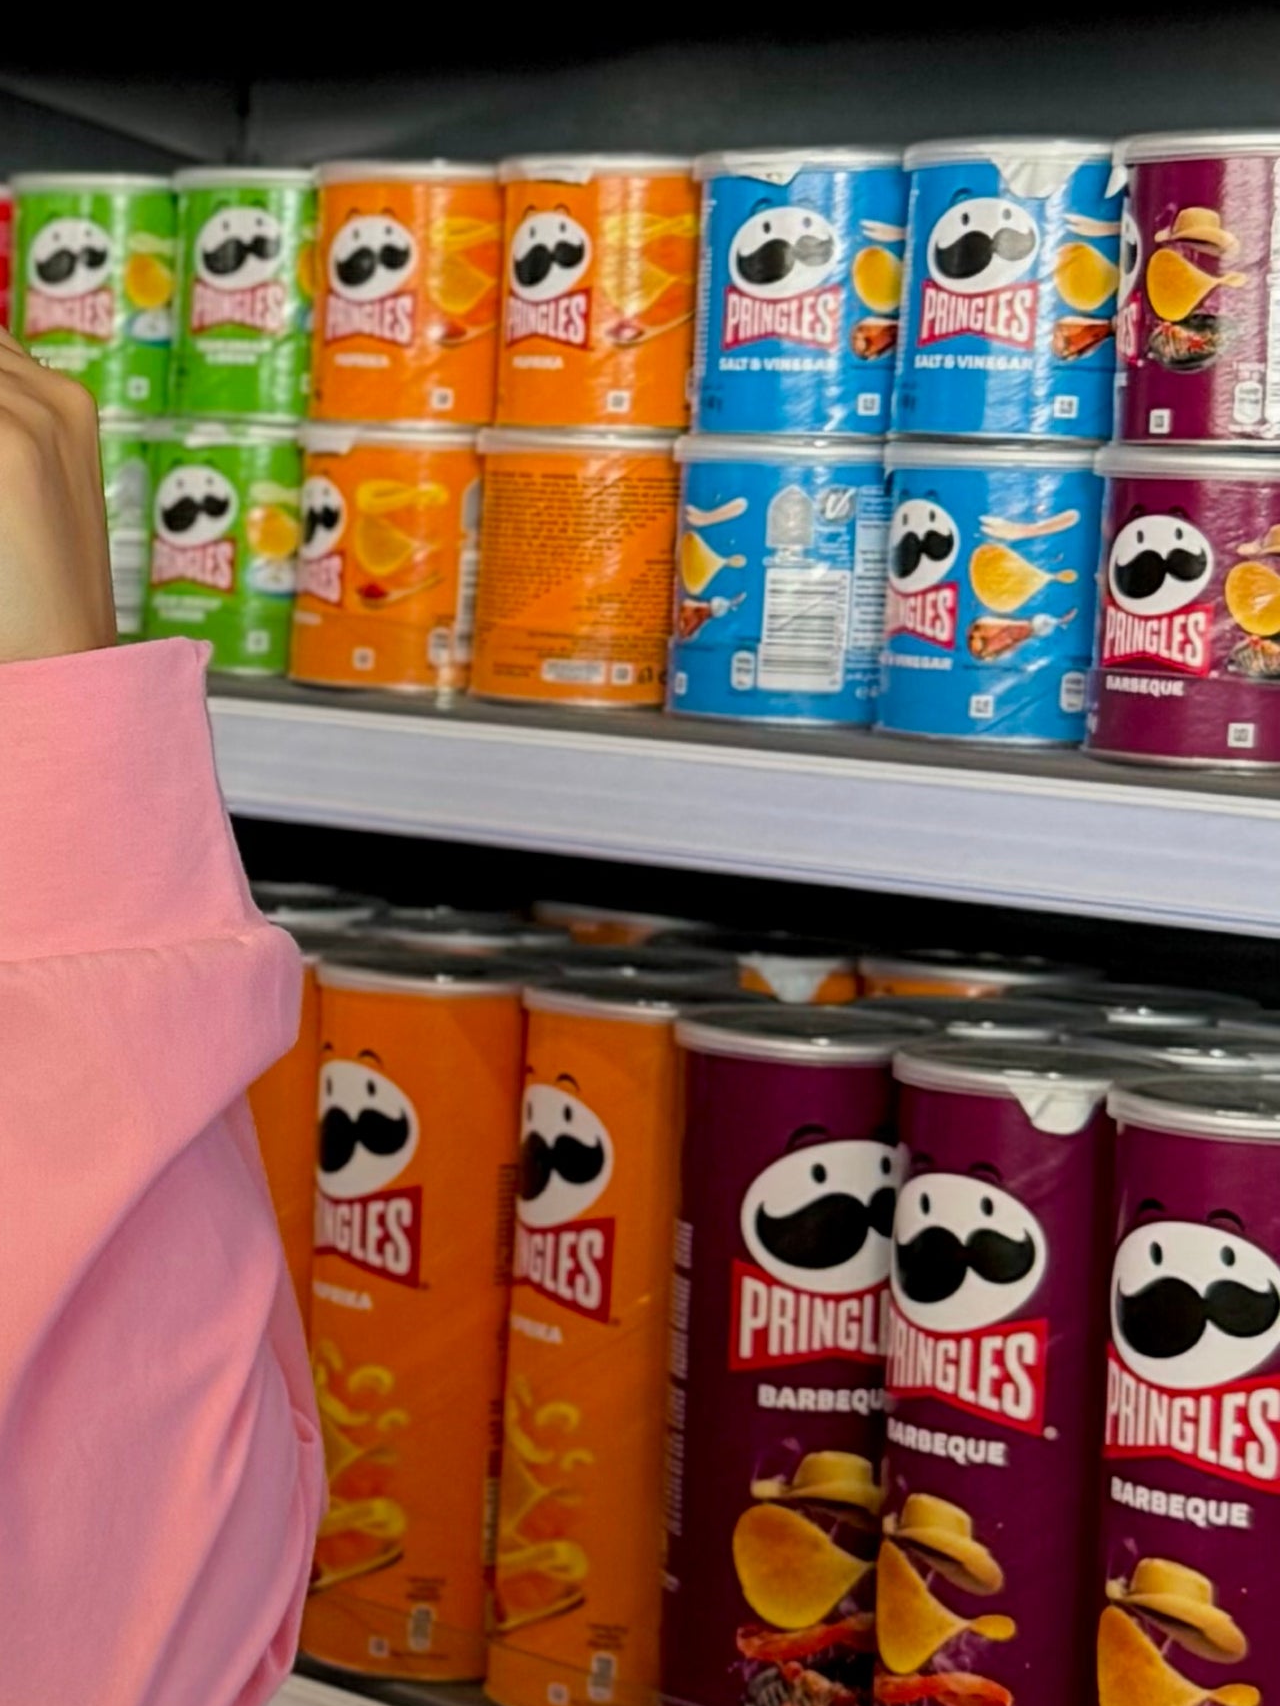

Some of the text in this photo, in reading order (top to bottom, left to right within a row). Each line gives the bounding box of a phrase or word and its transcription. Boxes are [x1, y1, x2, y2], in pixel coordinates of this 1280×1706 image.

[725, 294, 837, 345] PRINGLES
[920, 283, 1032, 343] PRINGLES
[1103, 605, 1208, 670] PRINGLES
[1105, 674, 1185, 697] BARBEQUE
[887, 1417, 1008, 1467] BARBEQUE
[1105, 1356, 1280, 1481] PRINGLES
[1110, 1475, 1252, 1530] BARBEQUE
